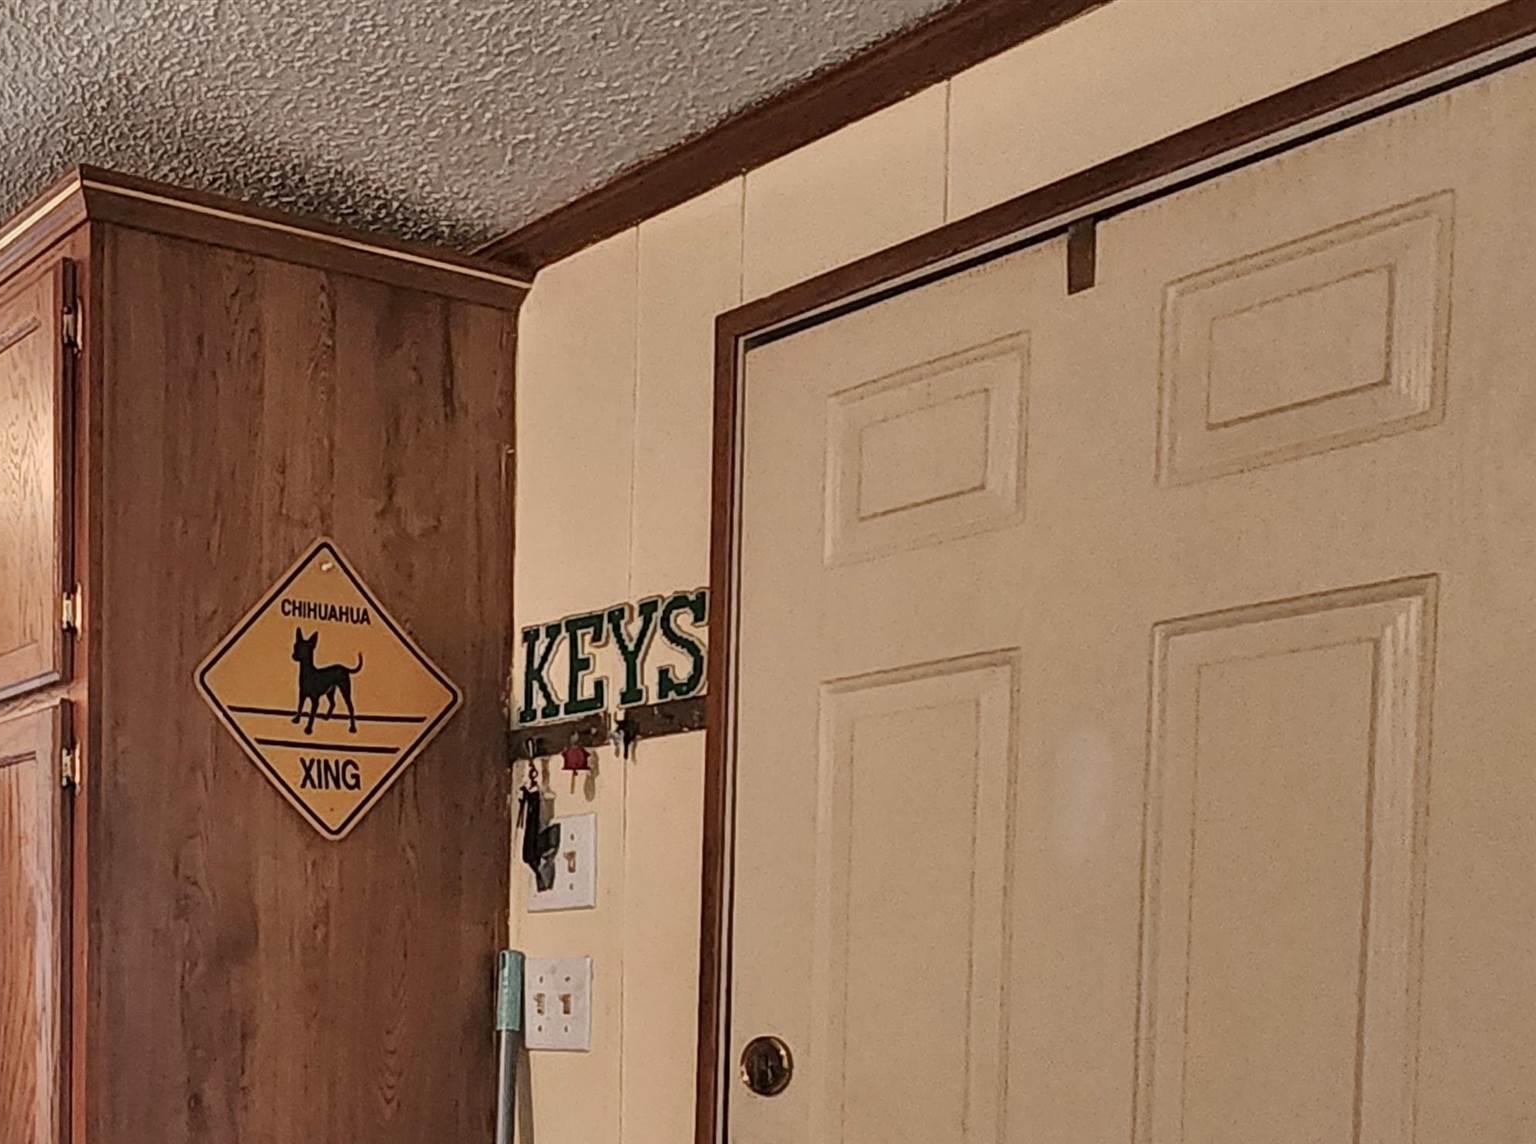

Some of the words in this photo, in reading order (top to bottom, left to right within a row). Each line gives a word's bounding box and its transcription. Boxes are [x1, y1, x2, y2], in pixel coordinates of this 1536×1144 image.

[280, 598, 371, 625] CHIHUAHUA
[518, 591, 707, 725] KEYS
[299, 756, 361, 790] XING
